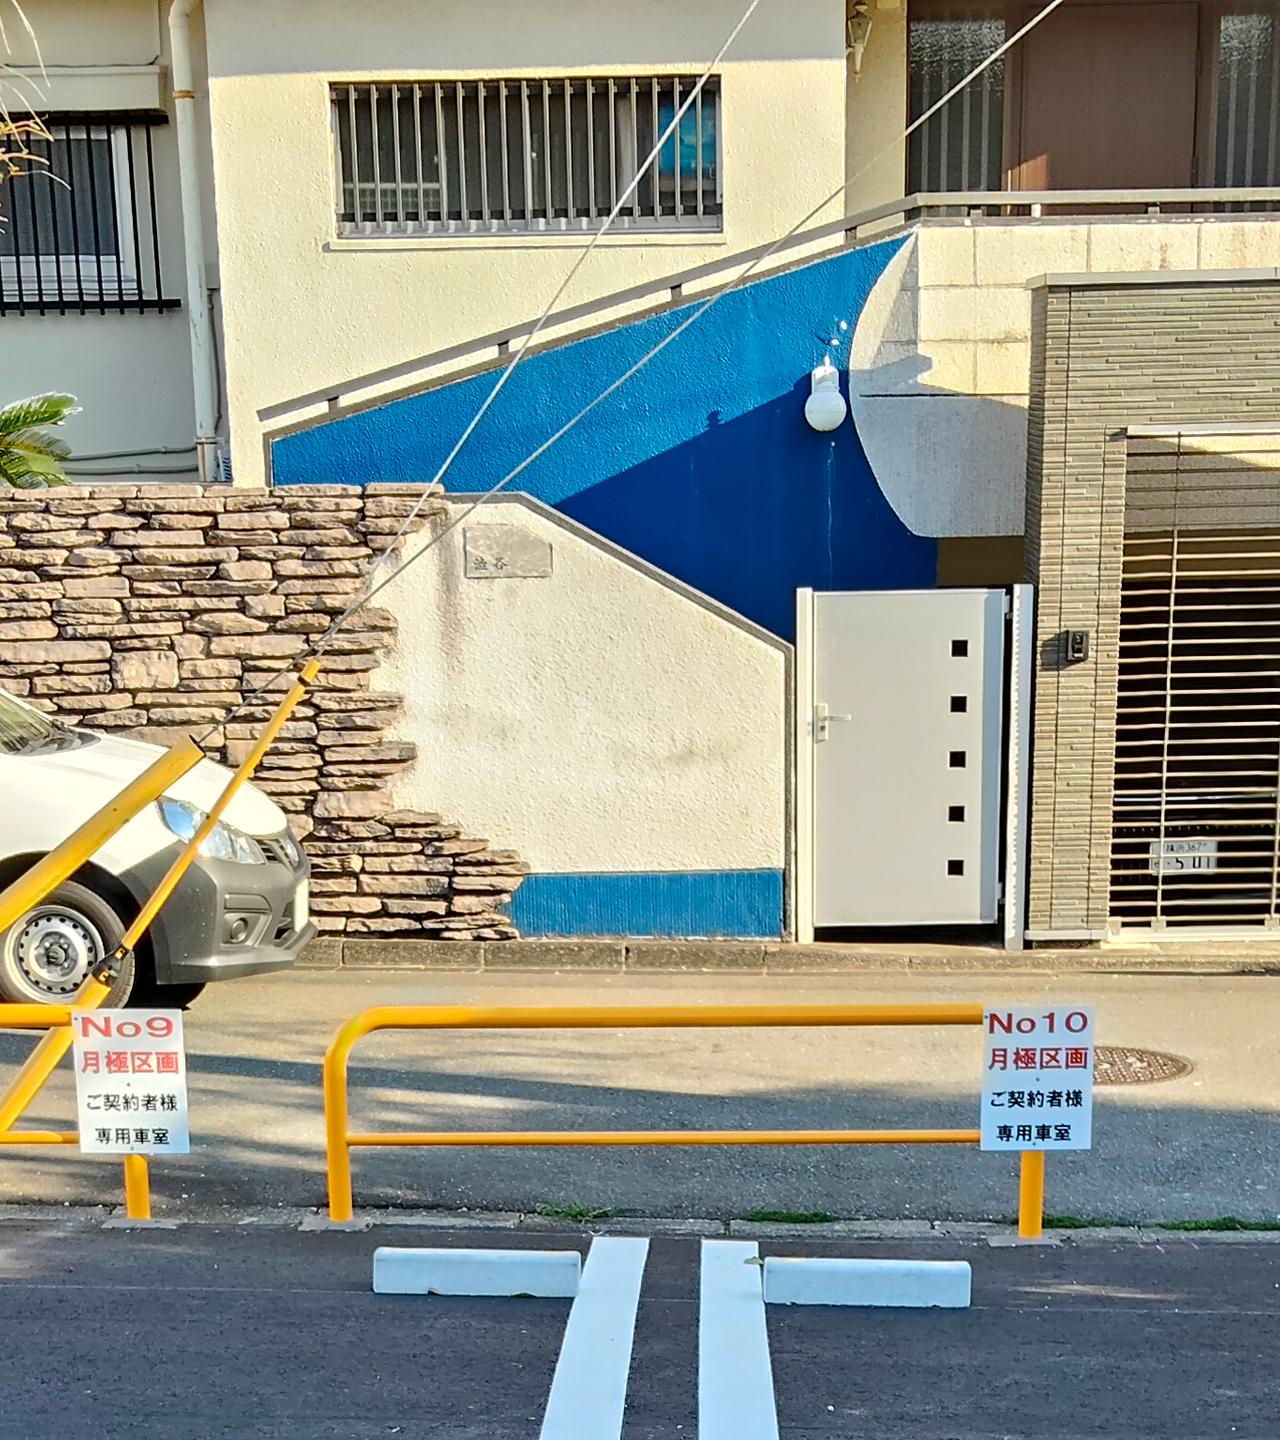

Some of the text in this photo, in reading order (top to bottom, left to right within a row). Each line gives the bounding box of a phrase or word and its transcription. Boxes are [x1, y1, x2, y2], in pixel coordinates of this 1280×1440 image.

[81, 1016, 175, 1038] No9
[988, 1011, 1089, 1034] No10
[81, 1051, 180, 1074] 月極区画
[988, 1047, 1089, 1070] 月極区画
[86, 1093, 178, 1112] ご契約者様
[990, 1090, 1083, 1108] ご契約者様
[95, 1128, 170, 1145] 専用車室
[996, 1124, 1072, 1142] 専用車室
